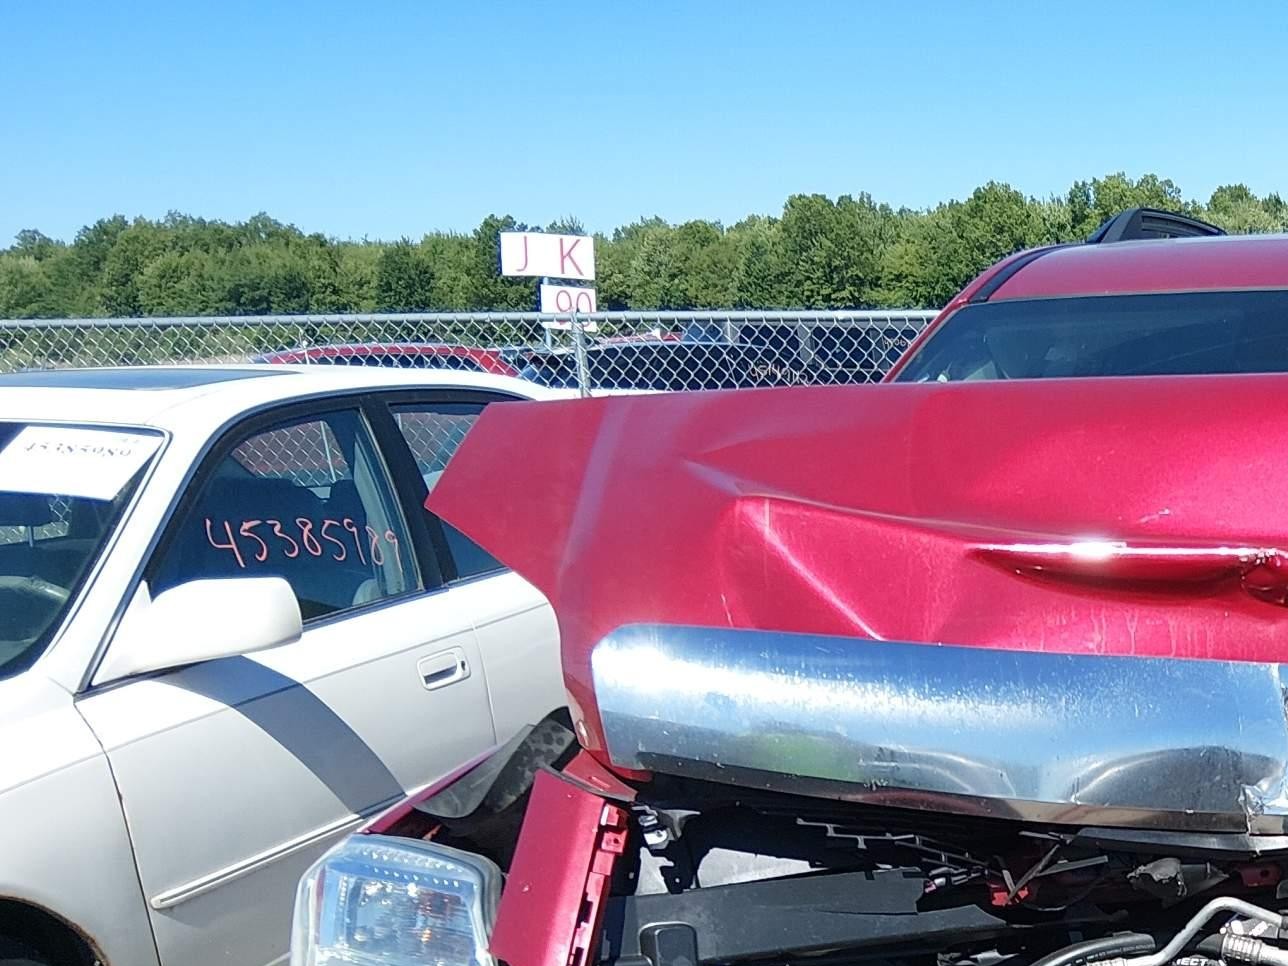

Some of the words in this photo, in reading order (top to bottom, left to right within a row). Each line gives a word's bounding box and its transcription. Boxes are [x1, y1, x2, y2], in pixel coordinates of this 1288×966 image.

[516, 235, 528, 272] J
[559, 237, 584, 276] K
[205, 517, 404, 573] 45385989
